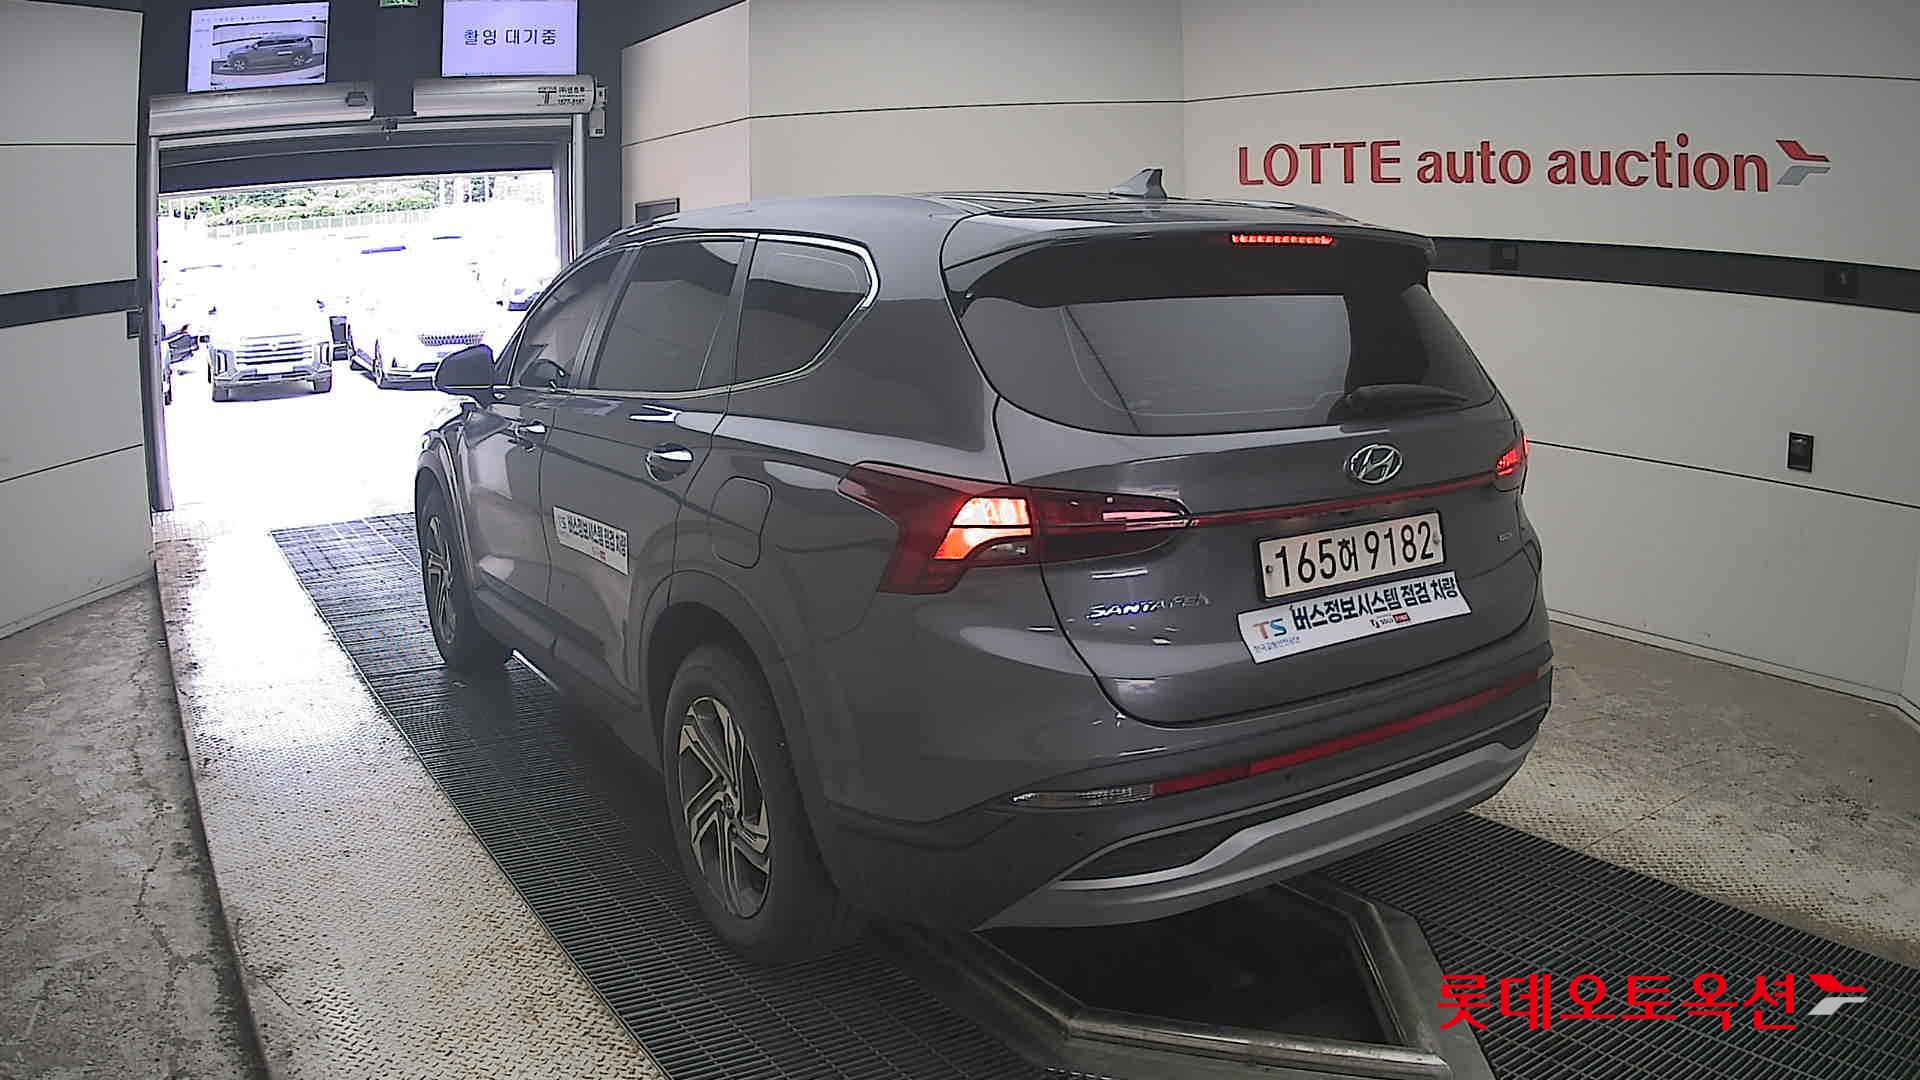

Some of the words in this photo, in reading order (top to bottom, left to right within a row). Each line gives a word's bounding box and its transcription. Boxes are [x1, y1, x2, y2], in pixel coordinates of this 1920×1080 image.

[505, 29, 557, 46] 대기중
[1239, 140, 1401, 187] LOTTE
[1416, 140, 1533, 185] auto
[1547, 133, 1769, 193] auction
[1275, 538, 1360, 588] 165허
[1364, 521, 1434, 571] 9182
[1085, 599, 1165, 620] SANTA
[1290, 587, 1402, 630] 버스정보시스템
[1400, 581, 1432, 607] 점검
[1430, 576, 1458, 600] 차량
[1253, 618, 1288, 640] TS
